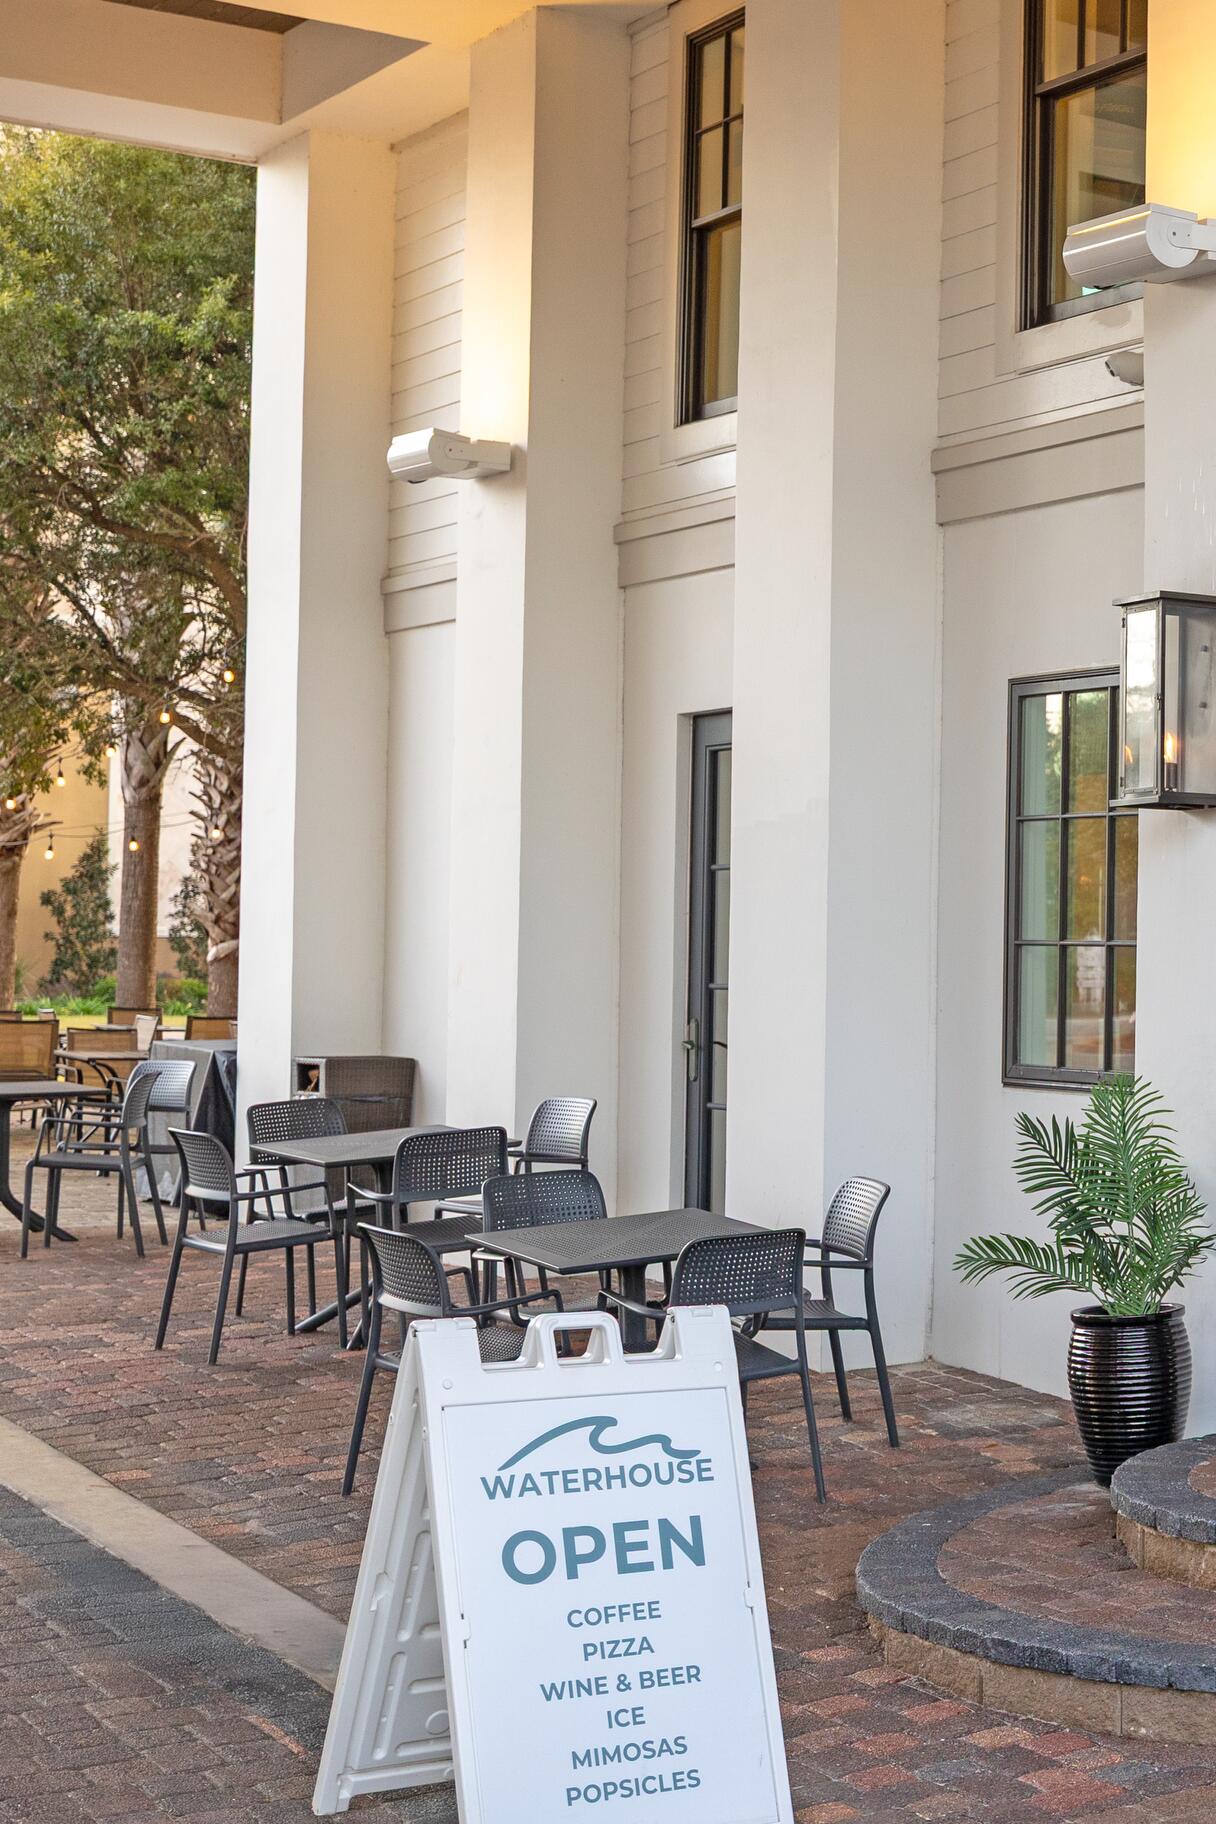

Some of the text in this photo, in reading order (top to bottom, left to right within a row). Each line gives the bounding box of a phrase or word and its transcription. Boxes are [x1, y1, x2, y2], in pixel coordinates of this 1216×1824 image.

[480, 1458, 714, 1500] WATERHOUSE
[502, 1515, 706, 1585] OPEN
[567, 1601, 661, 1628] COFFEE
[583, 1636, 655, 1661] PIZZA
[540, 1665, 701, 1702] WINE & BEER
[607, 1706, 646, 1729] ICE
[572, 1736, 687, 1769] MIMOSAS
[566, 1769, 701, 1806] POPSICLES
